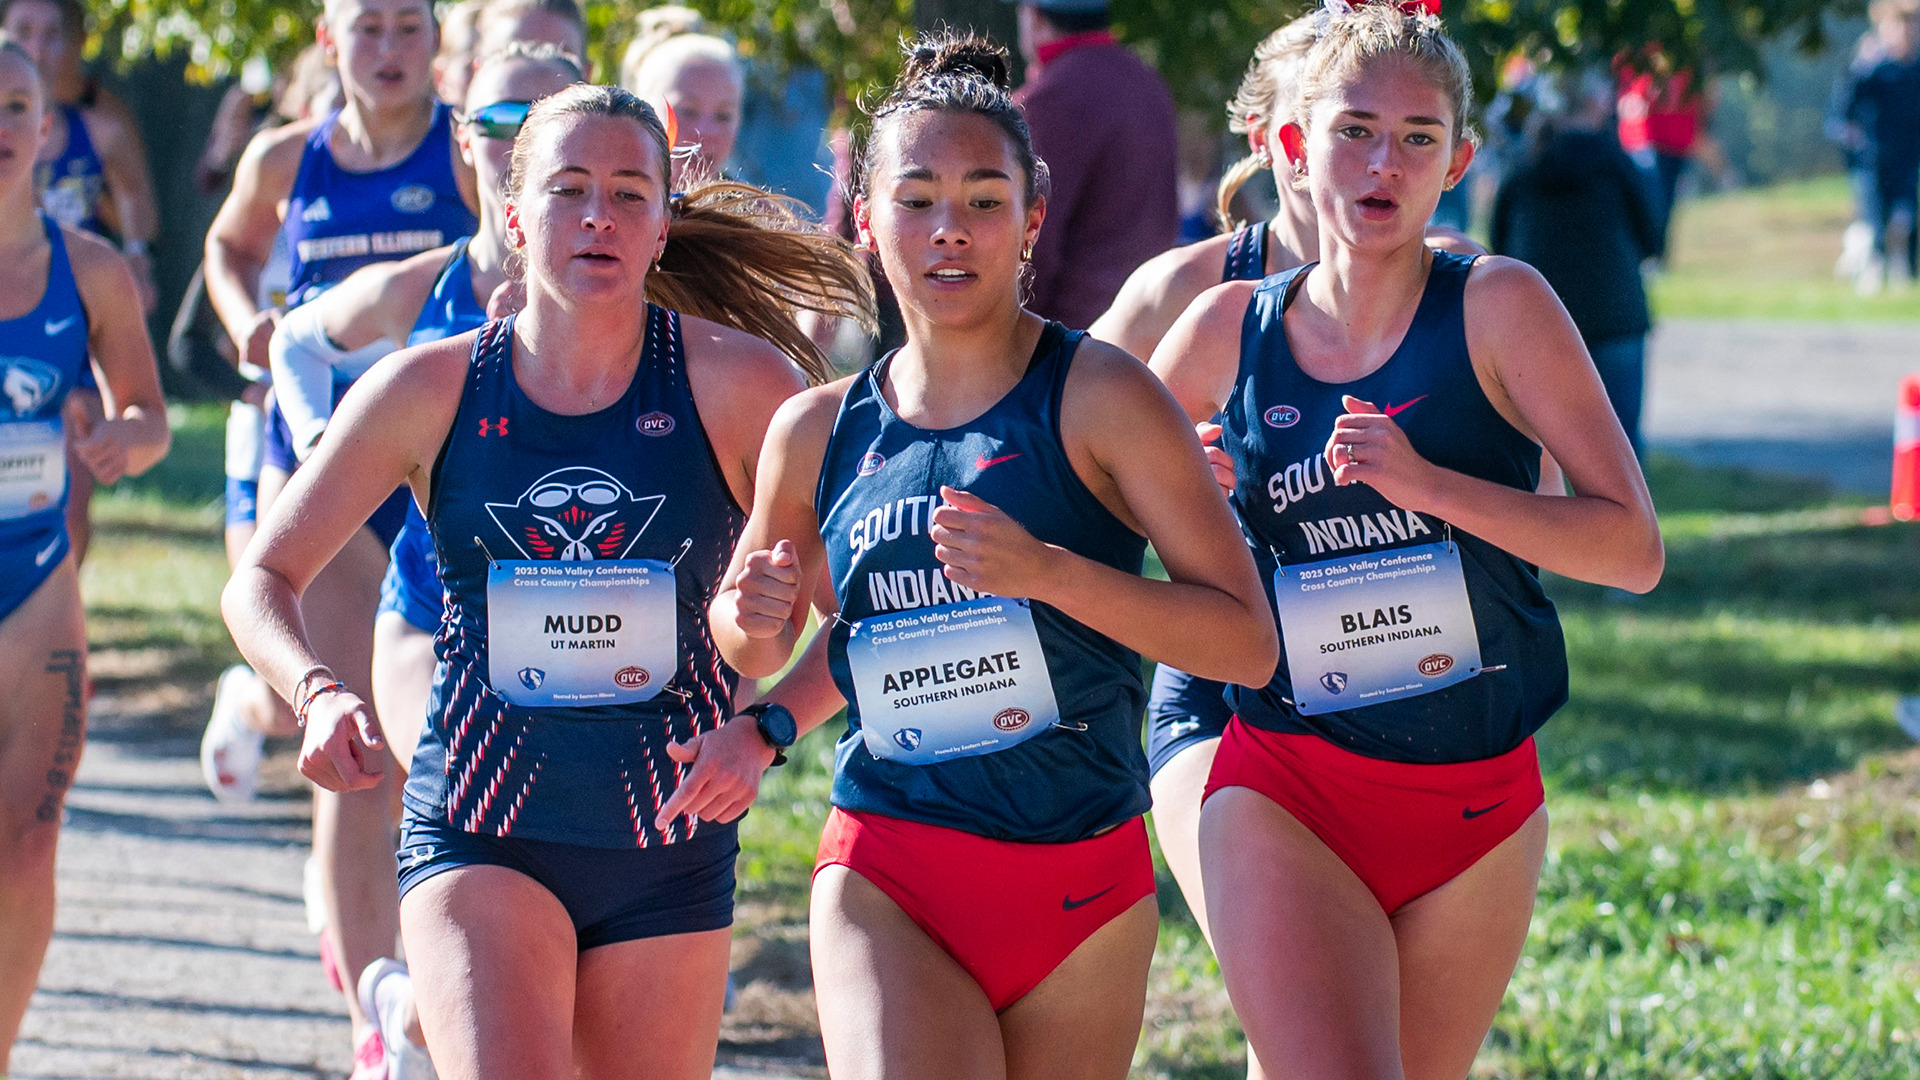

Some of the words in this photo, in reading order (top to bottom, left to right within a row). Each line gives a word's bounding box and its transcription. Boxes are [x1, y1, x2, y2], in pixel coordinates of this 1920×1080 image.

[644, 419, 665, 429] OVC
[850, 495, 949, 566] SOUT
[1298, 509, 1431, 555] INDIANA
[514, 566, 538, 576] 2025
[540, 566, 563, 576] Ohio
[564, 566, 593, 578] Valley
[595, 566, 649, 576] Conference
[1299, 568, 1323, 580] 2025
[1326, 565, 1349, 577] Ohio
[1349, 560, 1379, 573] Valley
[1380, 552, 1433, 568] Conference
[1300, 582, 1326, 592] Cross
[1327, 575, 1364, 589] Country
[1366, 563, 1436, 582] Championships
[514, 578, 539, 587] Cross
[540, 578, 577, 590] Country
[579, 577, 650, 588] Championships
[868, 568, 995, 611] INDIAN
[544, 614, 622, 634] MUDD
[870, 620, 894, 633] 2025
[896, 616, 919, 629] Ohio
[920, 611, 950, 625] Valley
[951, 603, 1003, 619] Conference
[872, 634, 897, 646] Cross
[898, 627, 936, 641] Country
[937, 615, 1007, 634] Championships
[1340, 604, 1412, 634] BLAIS
[550, 640, 565, 650] UT
[568, 639, 615, 650] MARTIN
[1320, 633, 1385, 654] SOUTHERN
[1388, 625, 1442, 642] INDIANA
[620, 672, 643, 683] OVC
[882, 650, 1021, 695] APPLEGATE
[1424, 659, 1447, 672] OVC
[893, 688, 958, 709] SOUTHERN
[961, 677, 1017, 697] INDIANA
[1000, 714, 1023, 727] OVC
